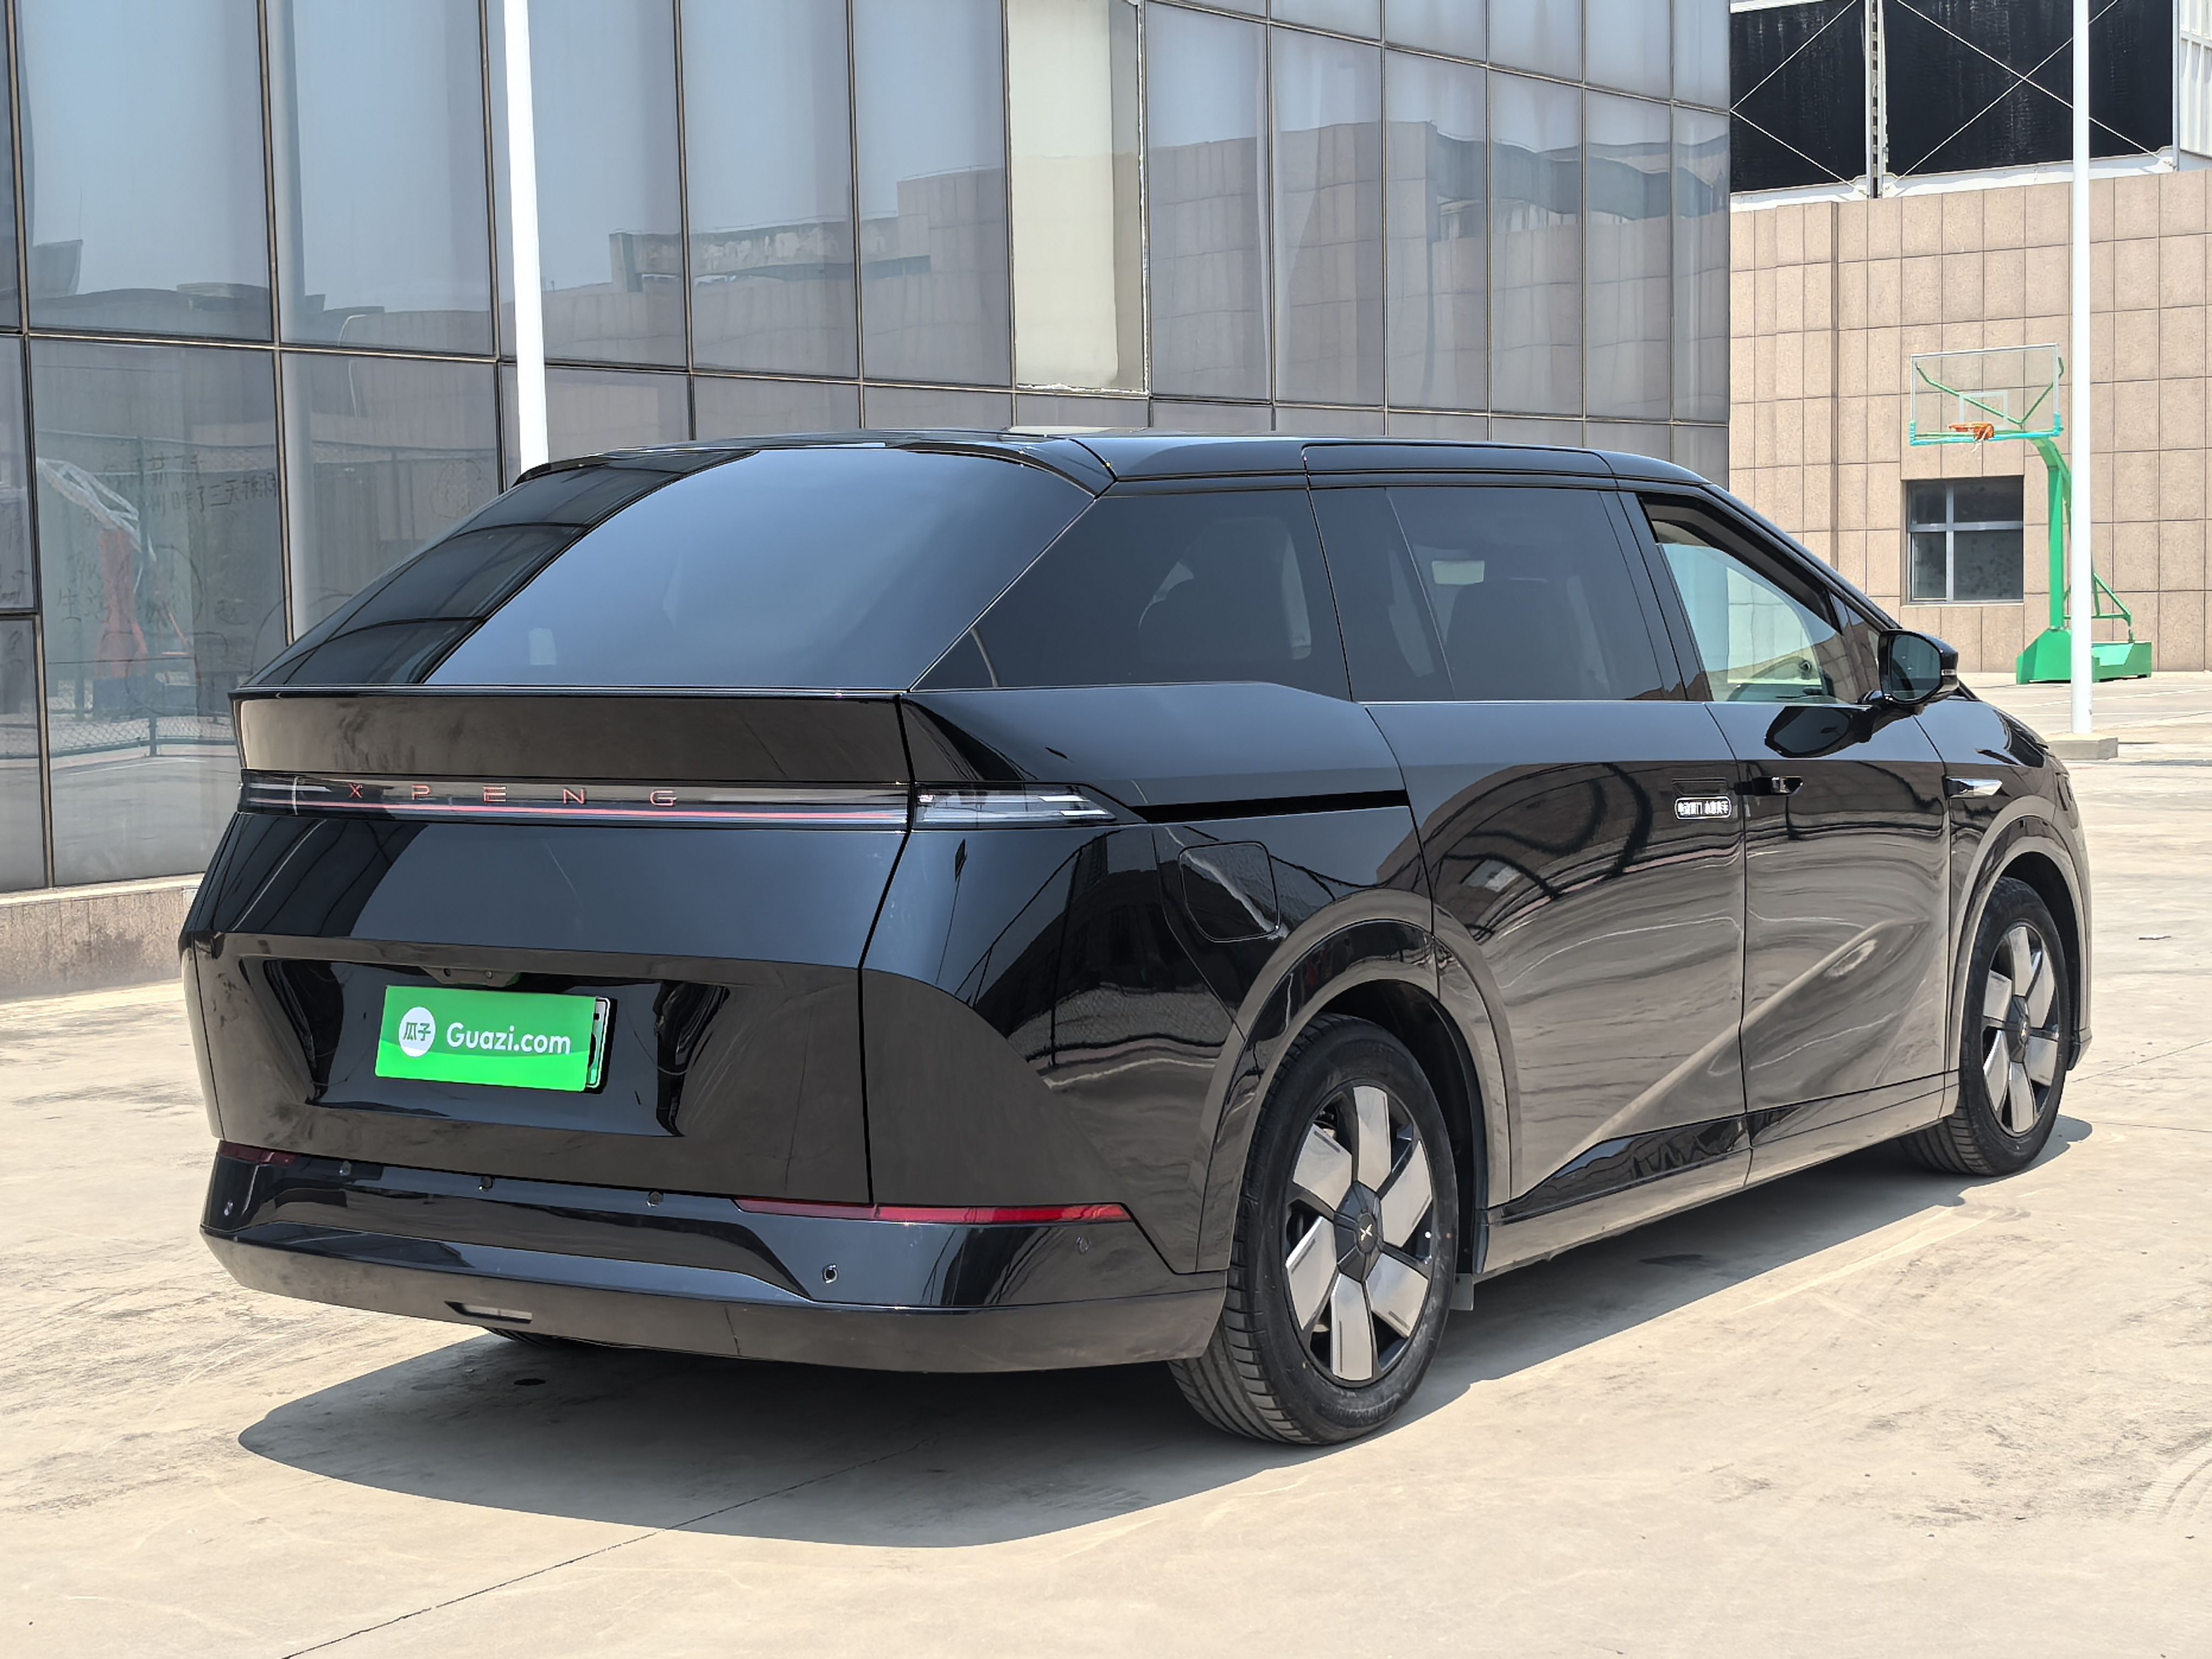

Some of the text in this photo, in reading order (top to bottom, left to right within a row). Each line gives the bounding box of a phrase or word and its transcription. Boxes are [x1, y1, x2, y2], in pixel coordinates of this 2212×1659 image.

[348, 783, 677, 806] XPENG
[402, 1022, 571, 1055] 瓜子 Guazi.com
